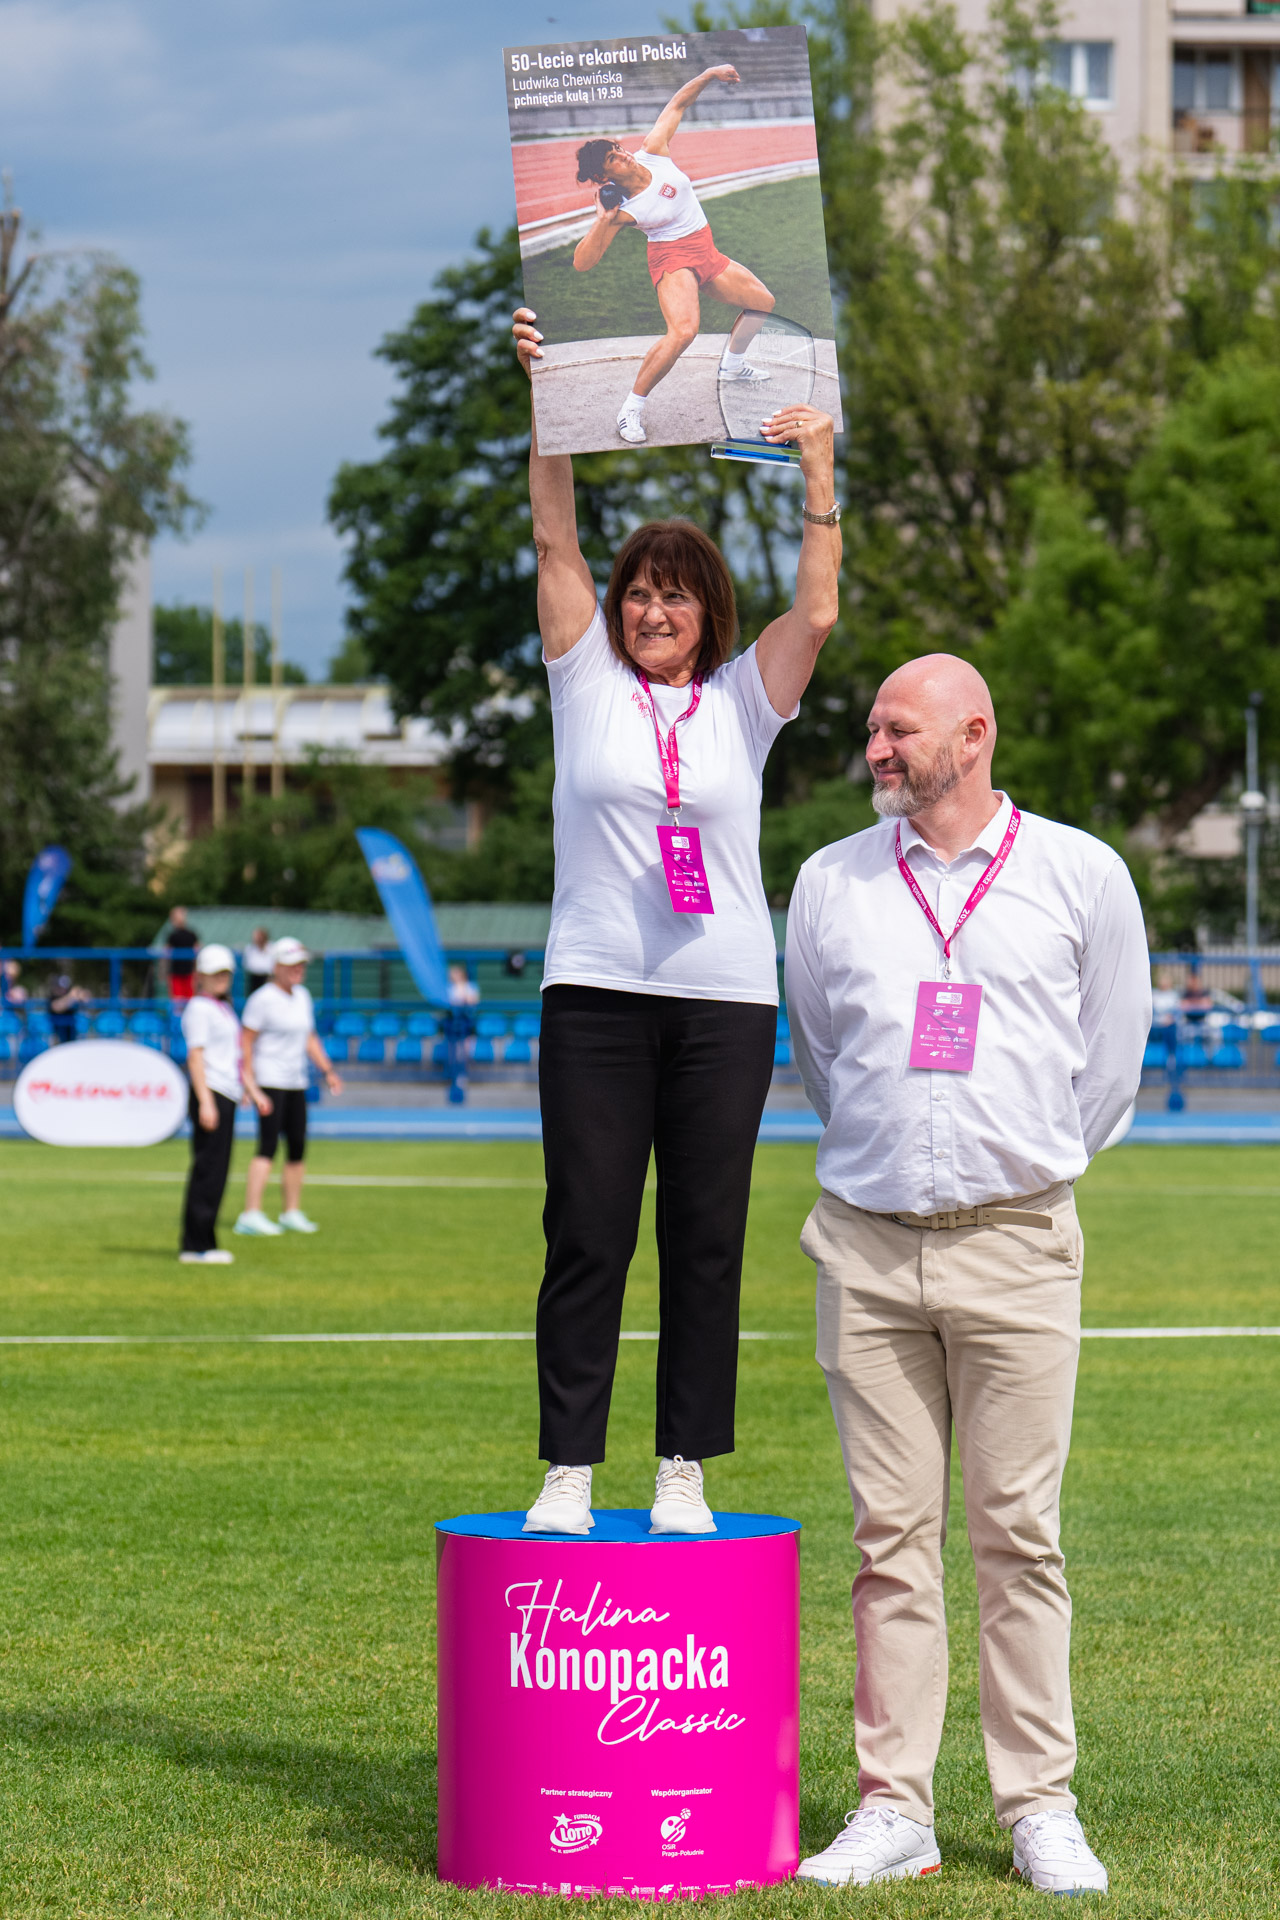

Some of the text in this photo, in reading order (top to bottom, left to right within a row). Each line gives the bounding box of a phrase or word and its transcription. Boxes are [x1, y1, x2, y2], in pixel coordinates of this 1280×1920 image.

[511, 42, 687, 72] 50-lecie rekordu Polski
[512, 70, 622, 91] Ludwika Chewińska
[514, 90, 563, 109] pchnięcie
[566, 89, 589, 103] kulą
[597, 86, 623, 100] 19.58
[1008, 814, 1019, 835] 2026
[982, 857, 1004, 885] Konopacka
[505, 1578, 670, 1647] Halina
[510, 1632, 729, 1705] Konopacka
[597, 1694, 746, 1745] Classic
[540, 1788, 613, 1798] Partner strategiczny
[651, 1787, 713, 1798] Współorganizator
[573, 1813, 600, 1822] FUNDACJA
[560, 1825, 593, 1842] LOTTO
[661, 1849, 704, 1858] Praga-Południe
[658, 1884, 674, 1894] 4F
